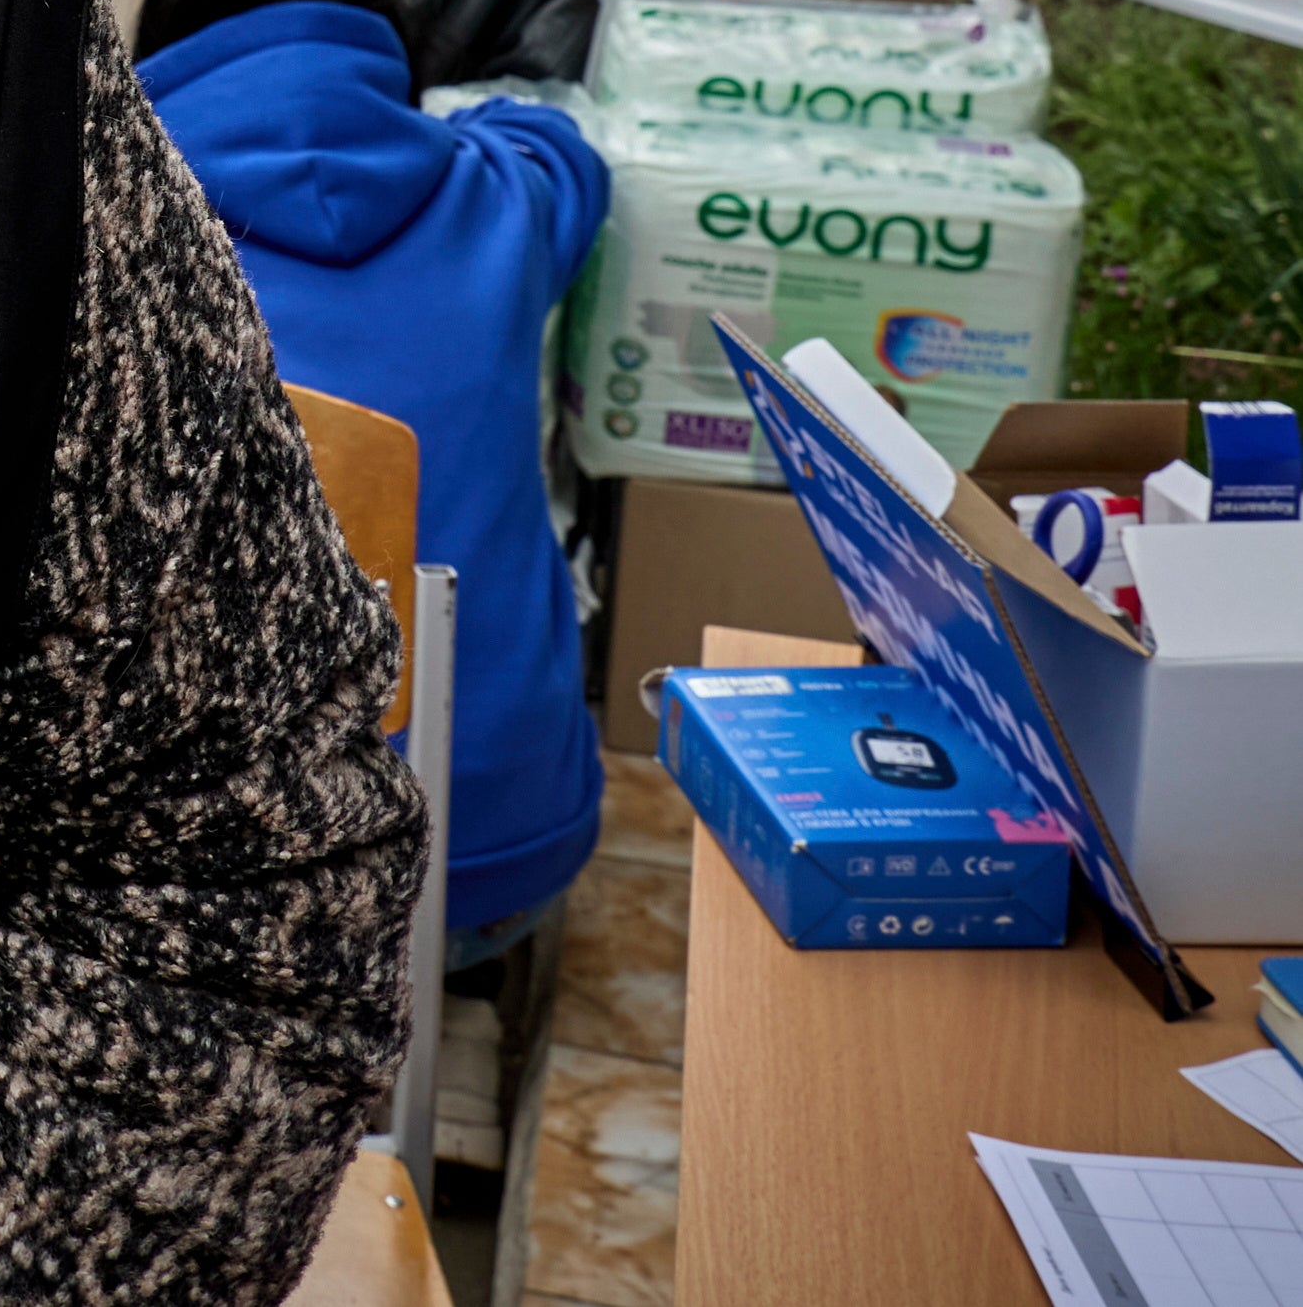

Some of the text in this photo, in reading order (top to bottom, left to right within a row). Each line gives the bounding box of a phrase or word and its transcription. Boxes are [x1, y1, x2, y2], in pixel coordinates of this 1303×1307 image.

[697, 75, 972, 136] evony
[697, 192, 992, 273] evony
[962, 328, 1031, 345] NIGHT
[797, 487, 1083, 820] МЕДИЧНА
